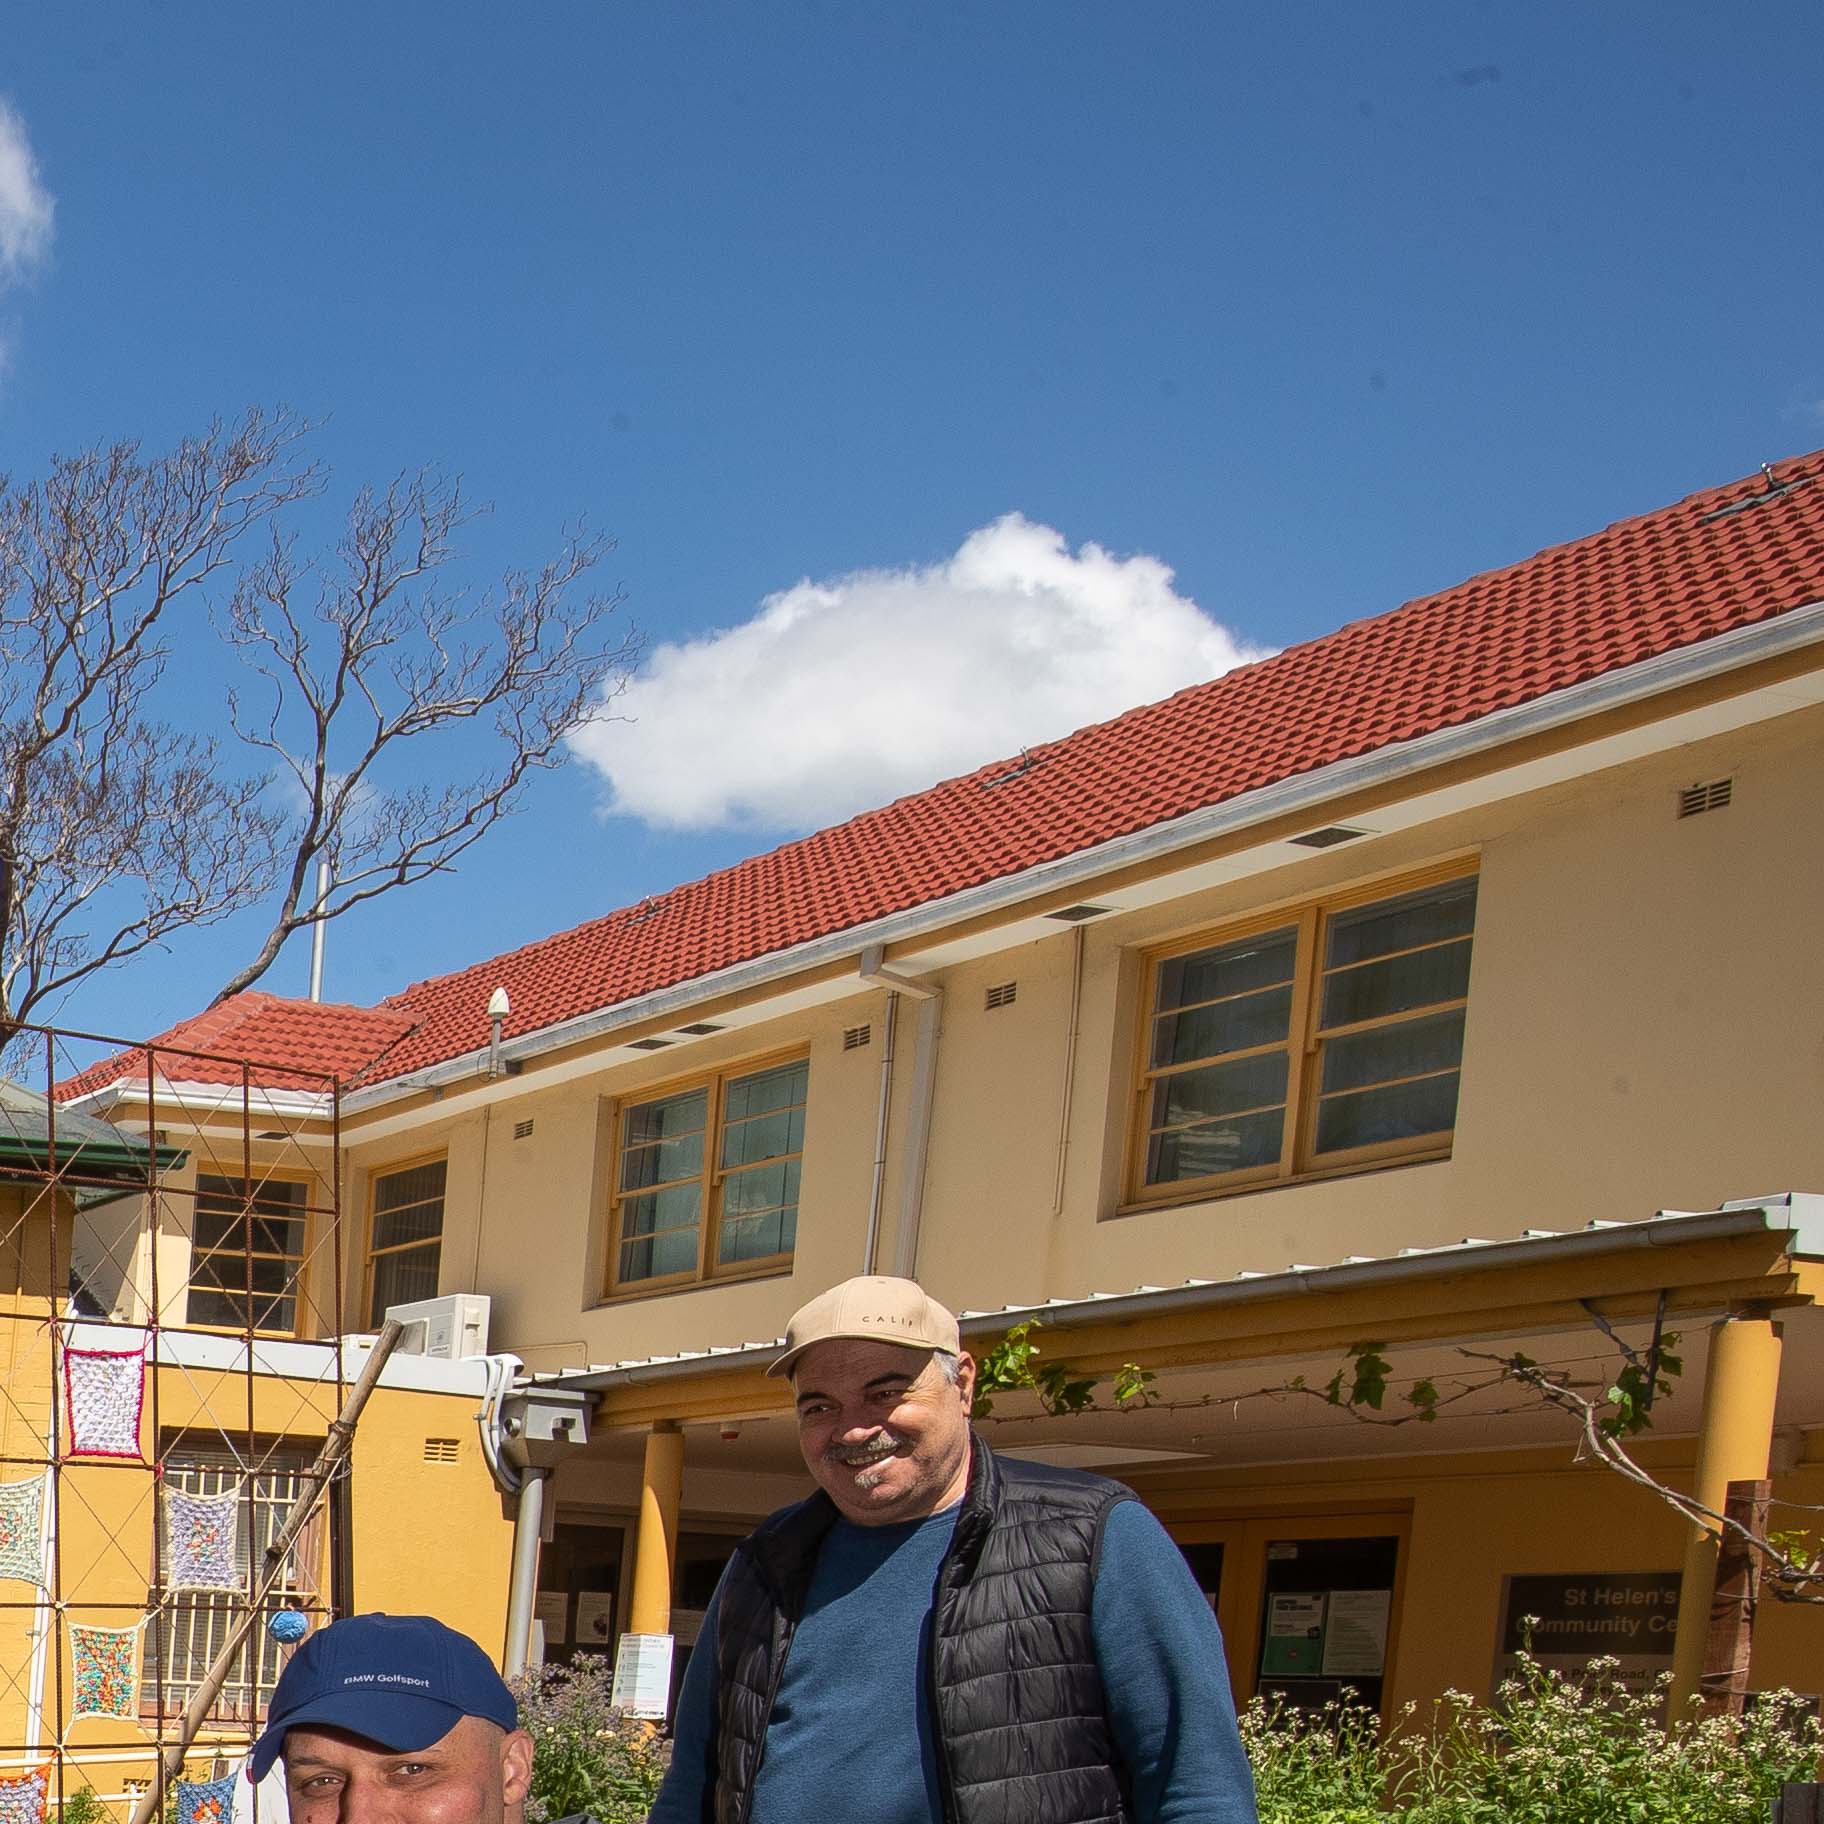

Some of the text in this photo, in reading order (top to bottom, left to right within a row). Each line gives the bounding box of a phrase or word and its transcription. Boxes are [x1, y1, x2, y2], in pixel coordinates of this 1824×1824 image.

[1565, 1587, 1677, 1605] St Helen's
[377, 1674, 430, 1688] Golfsport
